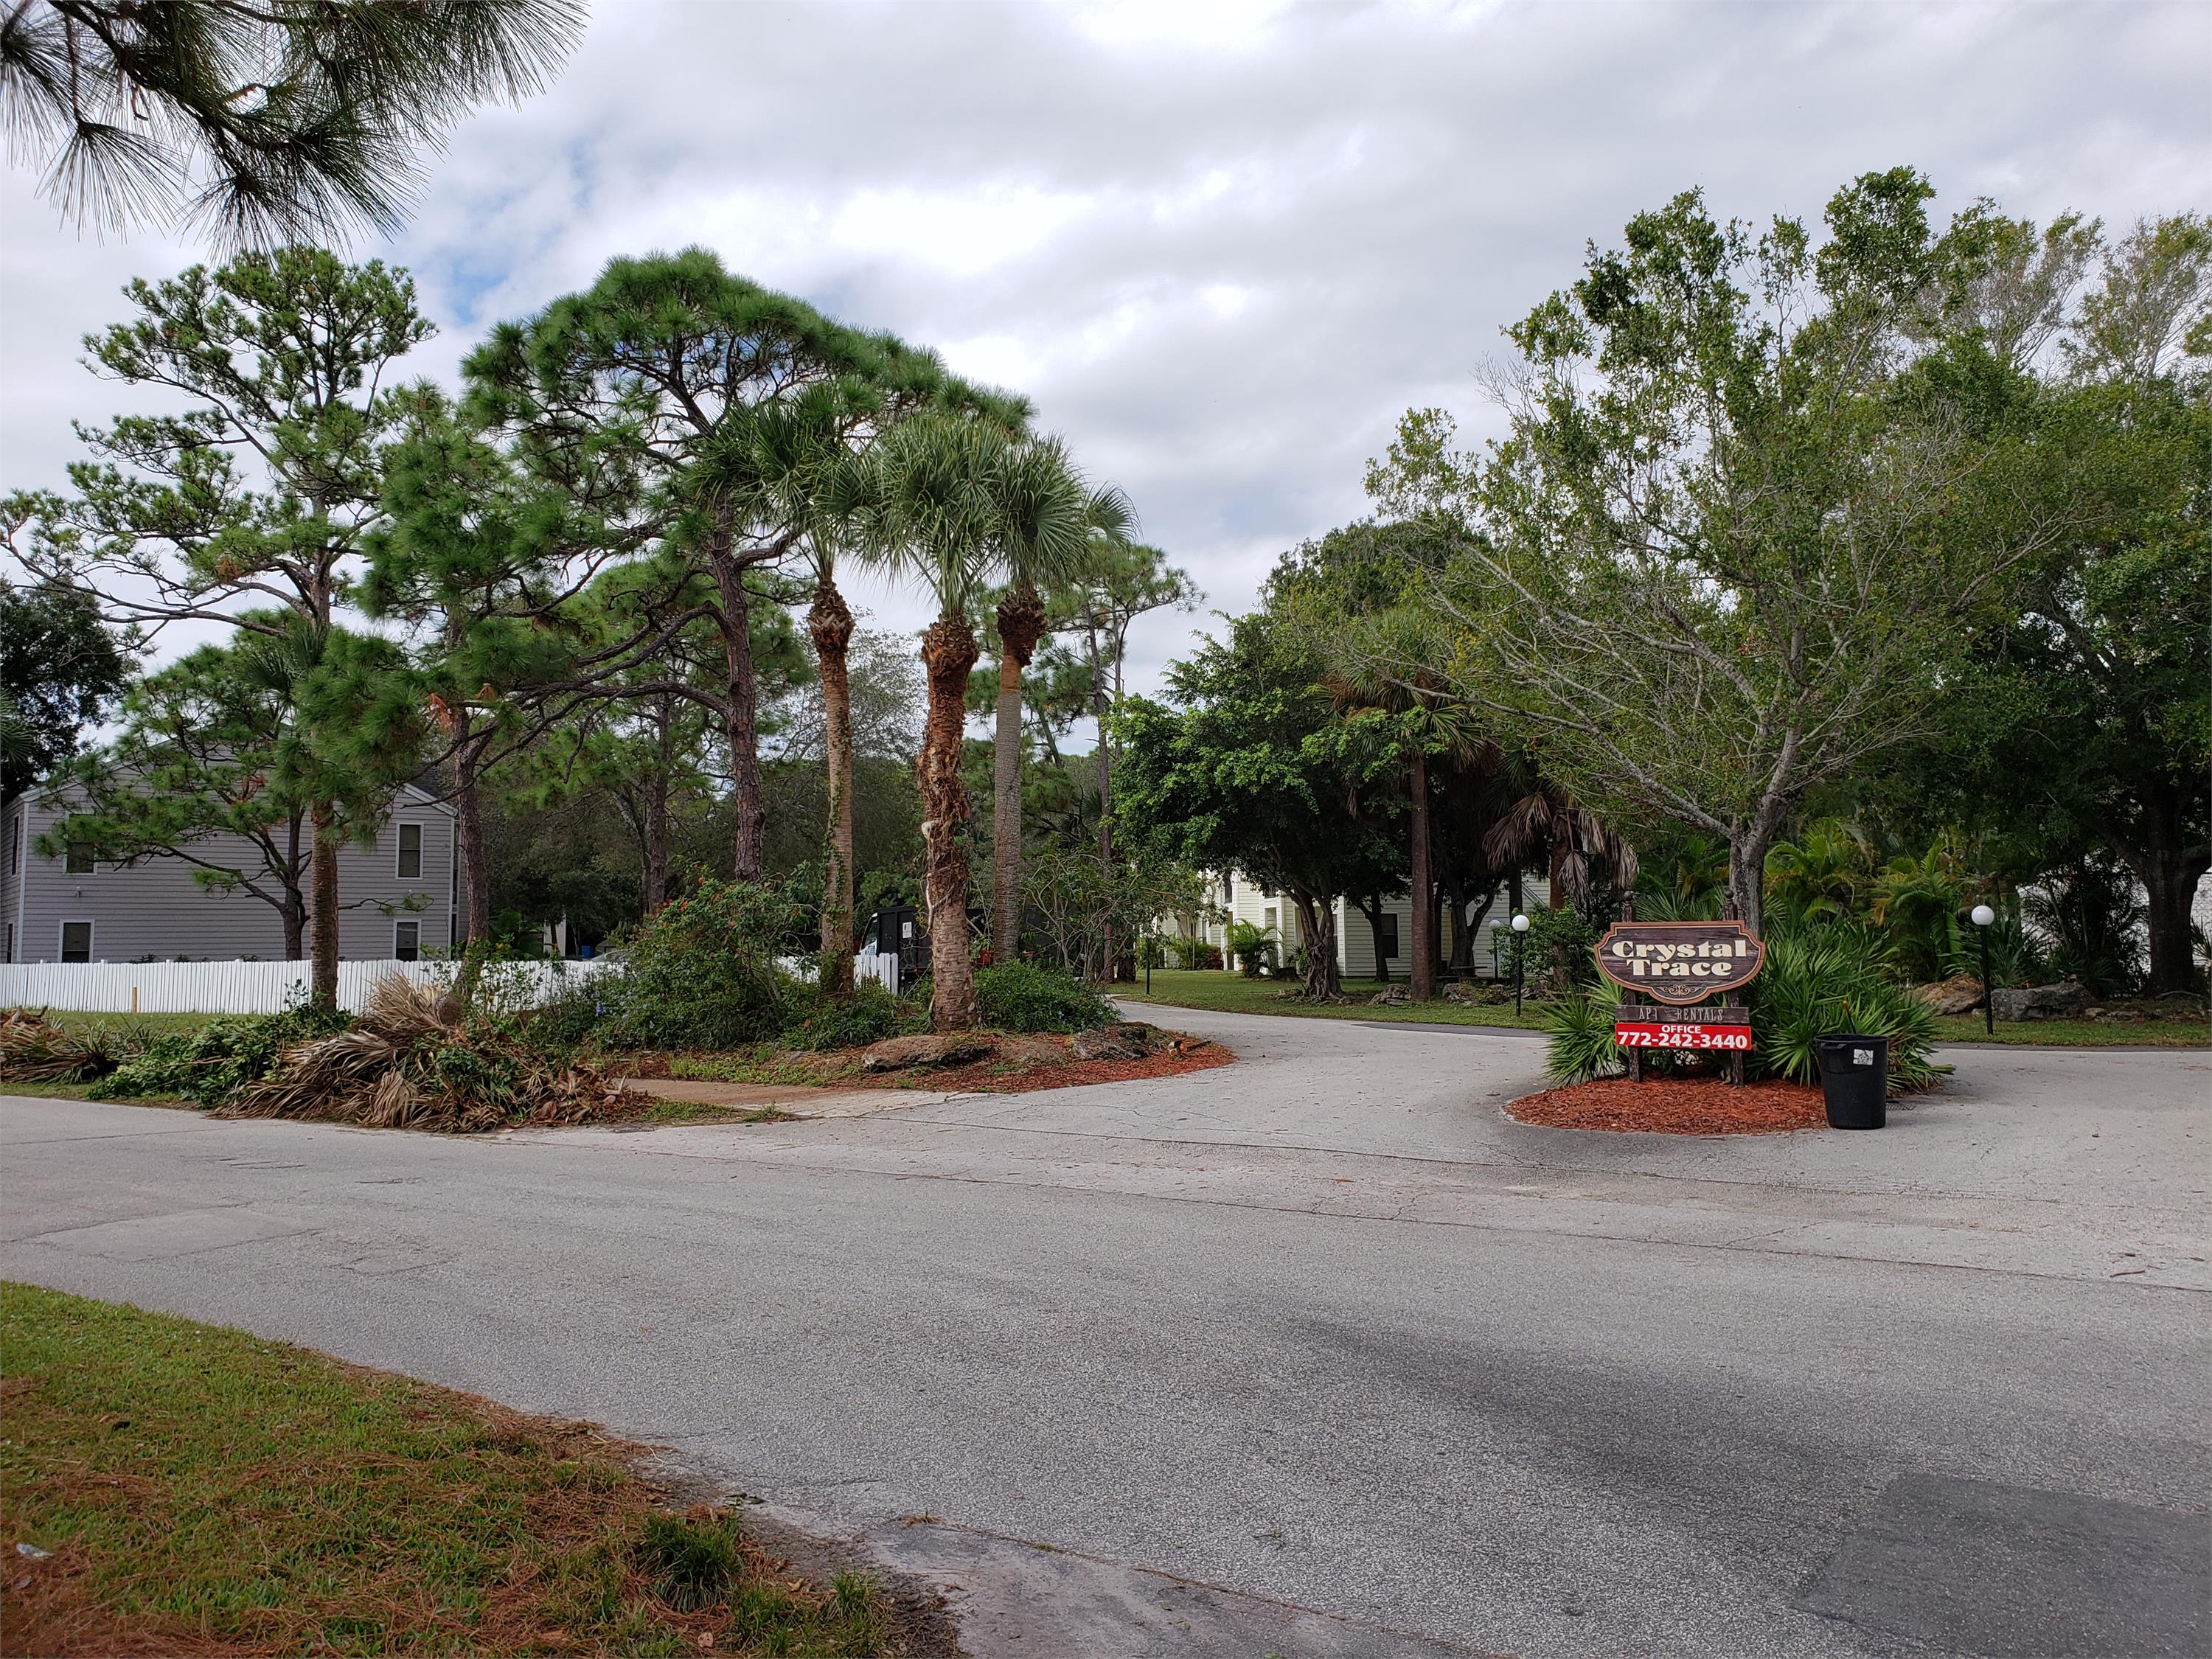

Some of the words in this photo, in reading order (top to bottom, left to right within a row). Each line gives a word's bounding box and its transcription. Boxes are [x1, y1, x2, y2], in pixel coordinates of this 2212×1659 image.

[1612, 939, 1747, 962] Crystal
[1626, 959, 1732, 976] Trace
[1677, 1008, 1724, 1021] RENTALS
[1661, 1025, 1702, 1034] OFFICE
[1618, 1032, 1747, 1048] 772-242-3440
